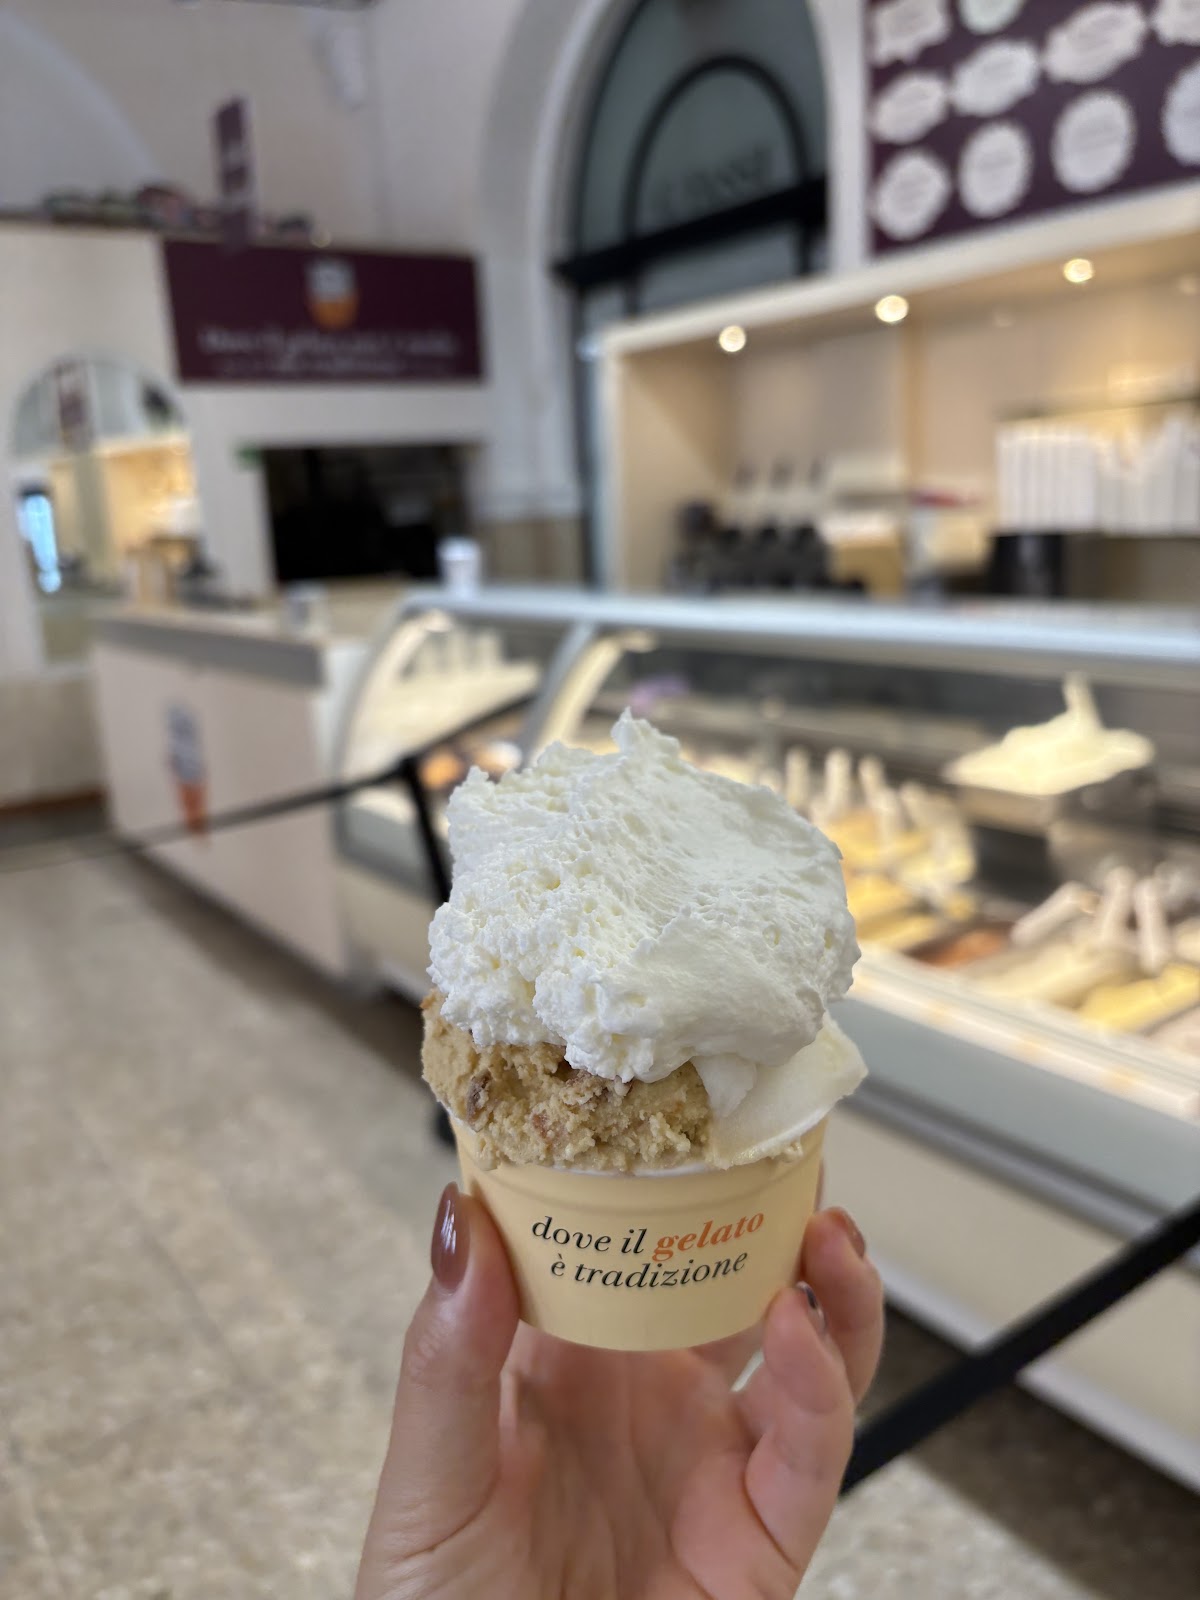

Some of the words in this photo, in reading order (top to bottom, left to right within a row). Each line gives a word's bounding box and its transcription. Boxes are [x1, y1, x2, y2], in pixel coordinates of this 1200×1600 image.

[531, 1215, 611, 1253] dove
[620, 1228, 648, 1255] il
[652, 1212, 765, 1262] gelato
[550, 1253, 566, 1277] è
[574, 1251, 748, 1288] tradizione
